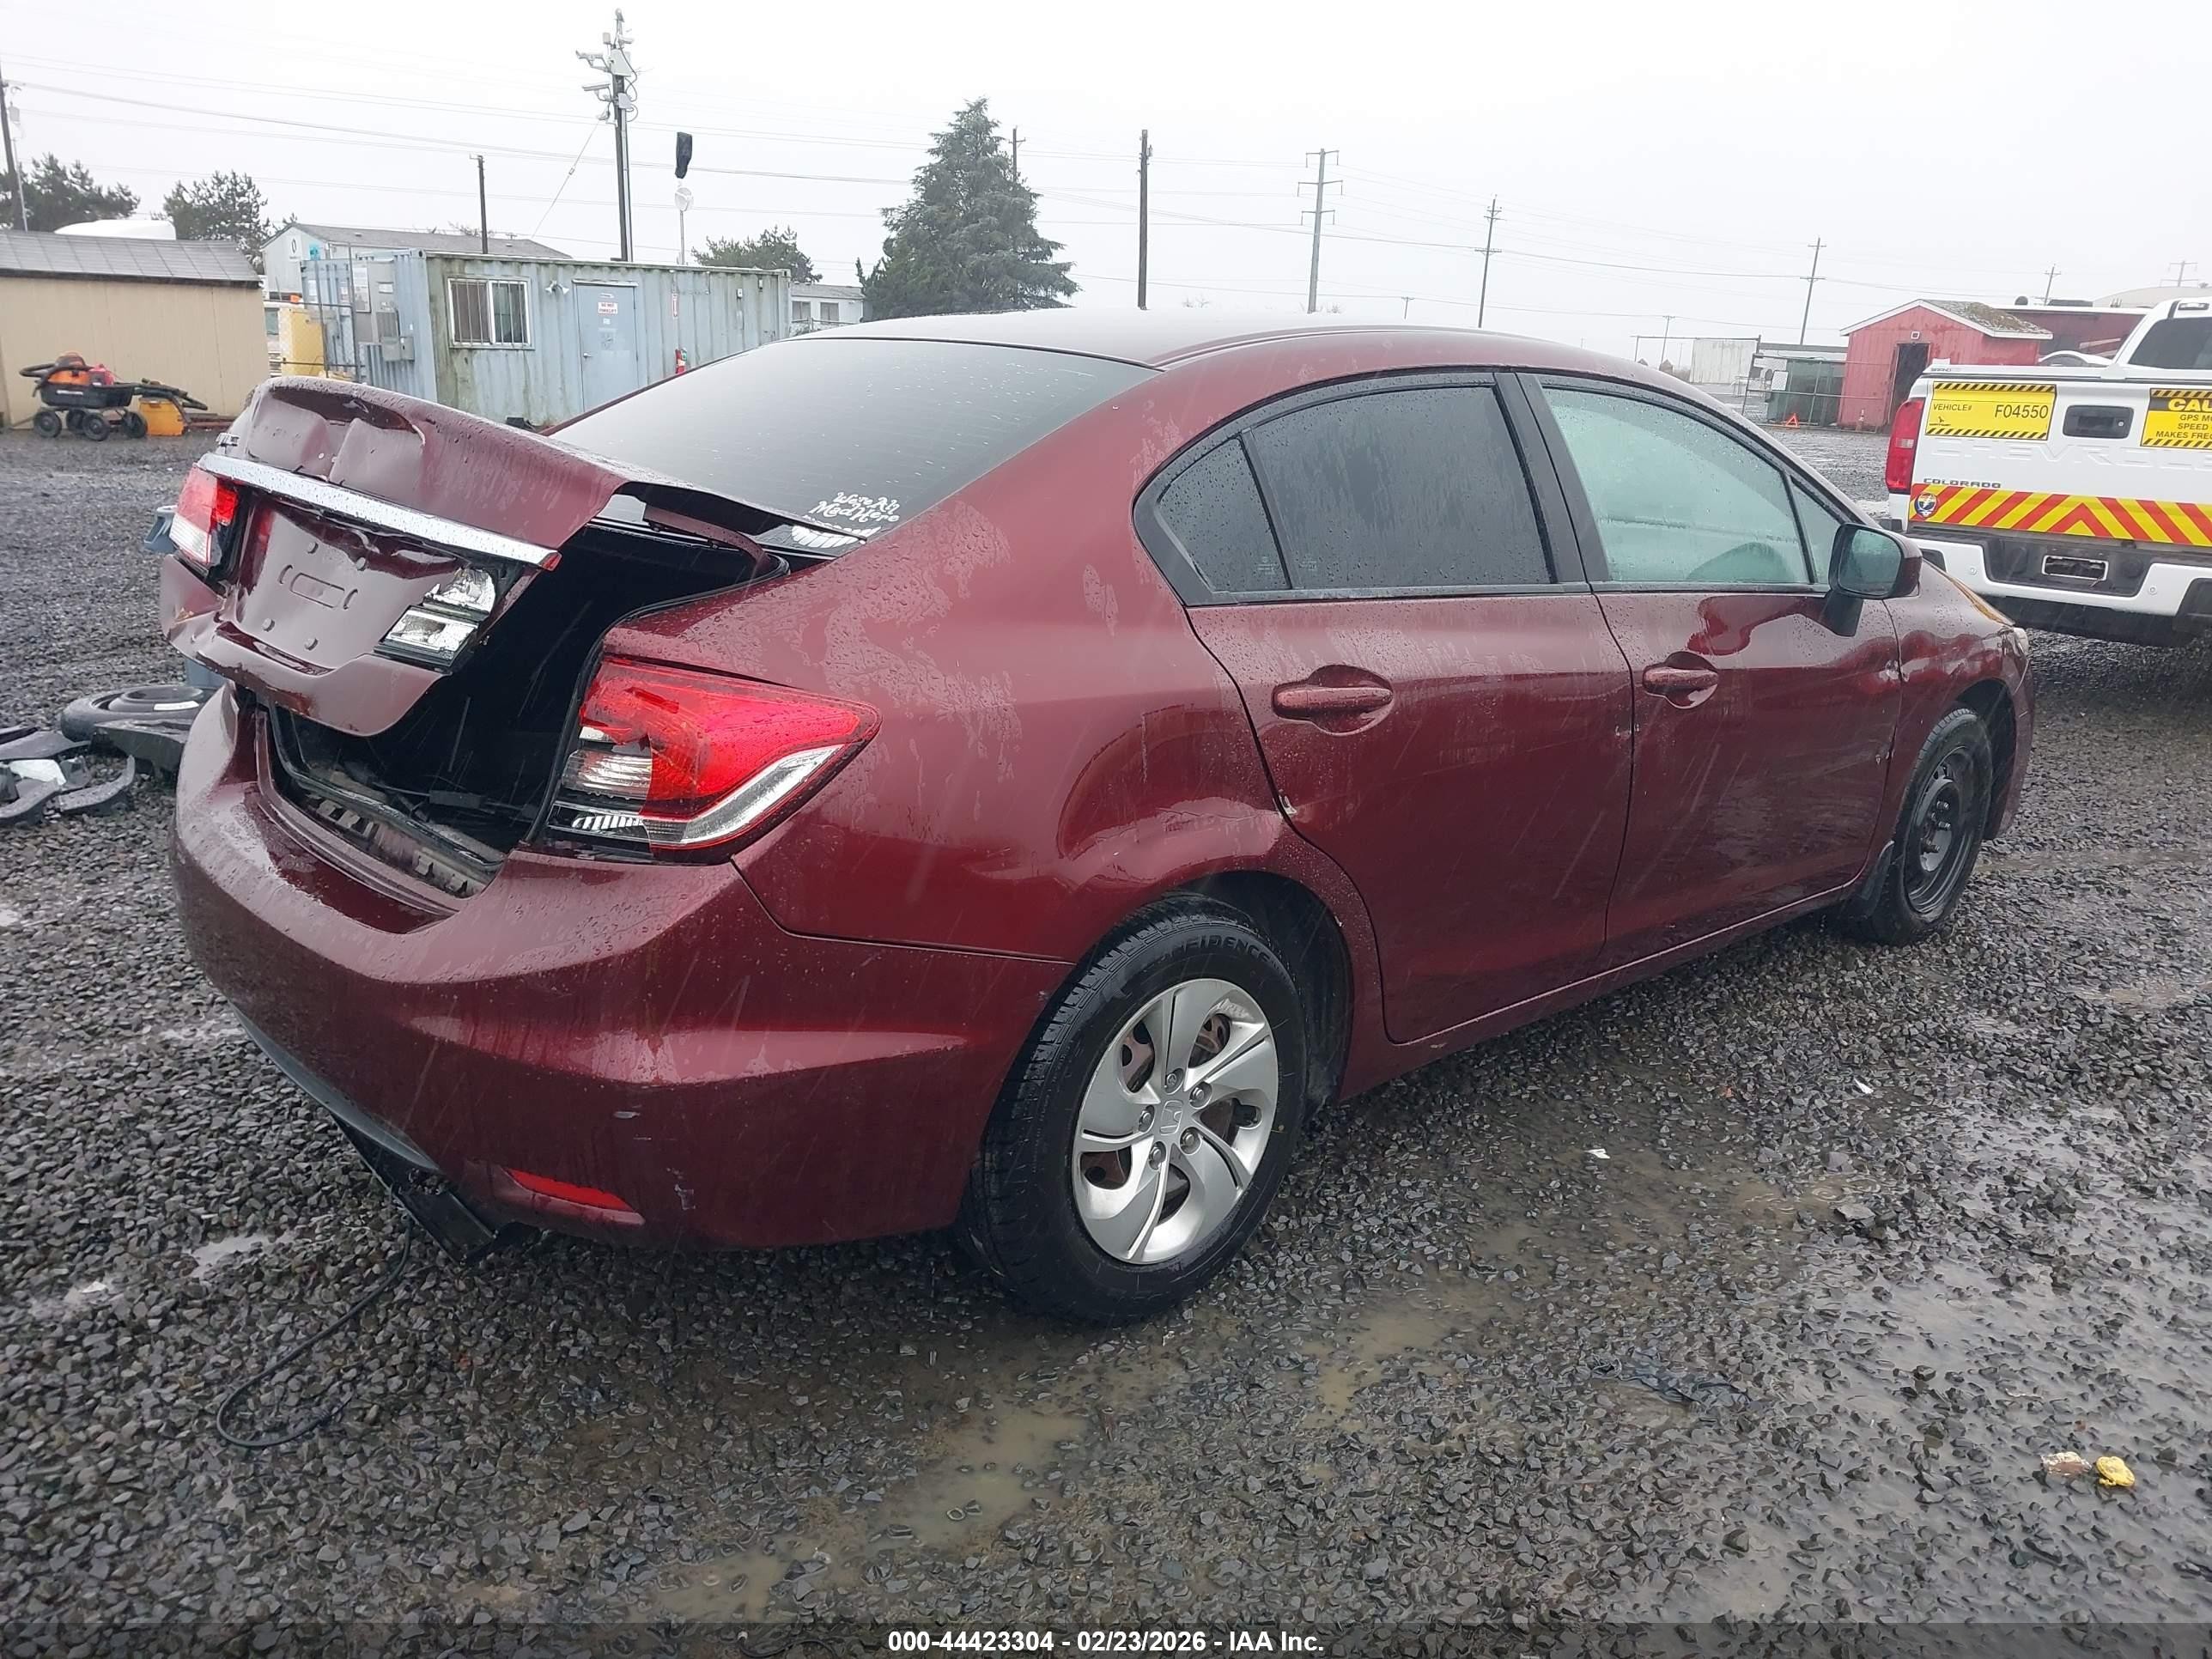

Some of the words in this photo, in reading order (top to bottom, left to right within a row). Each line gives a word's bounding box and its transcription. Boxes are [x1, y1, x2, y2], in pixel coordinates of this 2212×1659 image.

[1933, 403, 1972, 411] VEHICLE#
[1995, 404, 2049, 419] F04550
[2155, 430, 2189, 439] MAKES
[1923, 477, 2002, 489] COLORADO
[849, 507, 900, 522] Here
